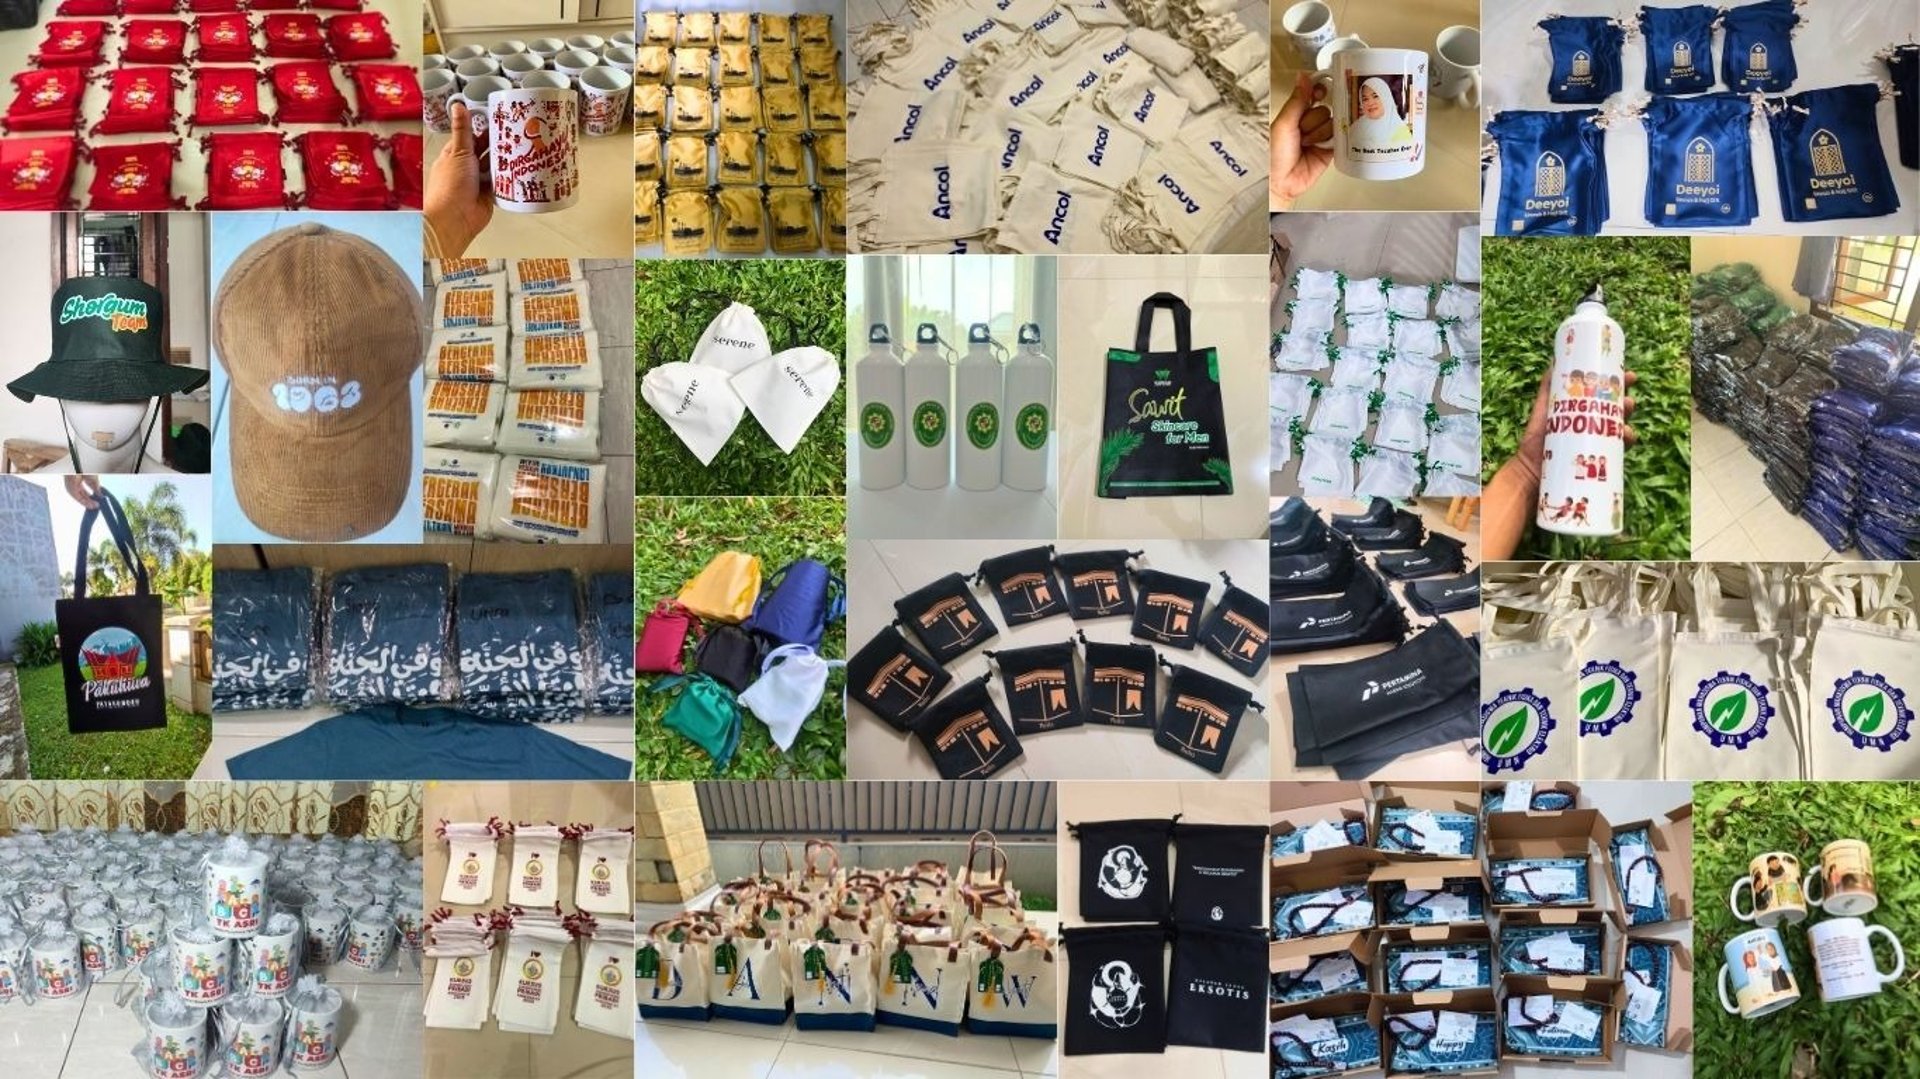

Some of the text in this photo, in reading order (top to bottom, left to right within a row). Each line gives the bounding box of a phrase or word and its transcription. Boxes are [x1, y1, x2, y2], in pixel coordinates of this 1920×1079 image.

[962, 18, 996, 44] Ancol
[1033, 10, 1062, 33] Ancol
[923, 56, 958, 91] Ancol
[1009, 74, 1044, 108] Ancol
[1133, 88, 1156, 123] Ancol
[1088, 125, 1110, 166] Ancol
[1209, 140, 1248, 178] Ancol
[1676, 184, 1720, 197] Deeyoi
[1810, 174, 1856, 189] Deeyoi
[932, 166, 951, 220] Ancol
[1157, 173, 1200, 214] Ancol
[1525, 196, 1569, 211] Deeyoi
[1043, 191, 1072, 245] Ancol
[112, 311, 148, 333] Team
[713, 335, 756, 351] serene
[784, 365, 814, 398] serene
[676, 379, 700, 416] serene
[1128, 387, 1187, 425] Sawit
[1150, 419, 1199, 432] Skincare
[1165, 431, 1210, 445] for Men
[1381, 668, 1423, 690] PERTAMINA
[216, 918, 258, 928] TK ASRI
[726, 957, 761, 1001] A
[900, 966, 944, 1010] N
[185, 987, 225, 998] TK ASRI
[1189, 982, 1250, 1000] EKSOTIS
[1318, 1039, 1346, 1054] Kasih
[1435, 1038, 1464, 1052] Happy
[155, 1069, 196, 1078] TK ASRI
[245, 1066, 269, 1075] ASRI
